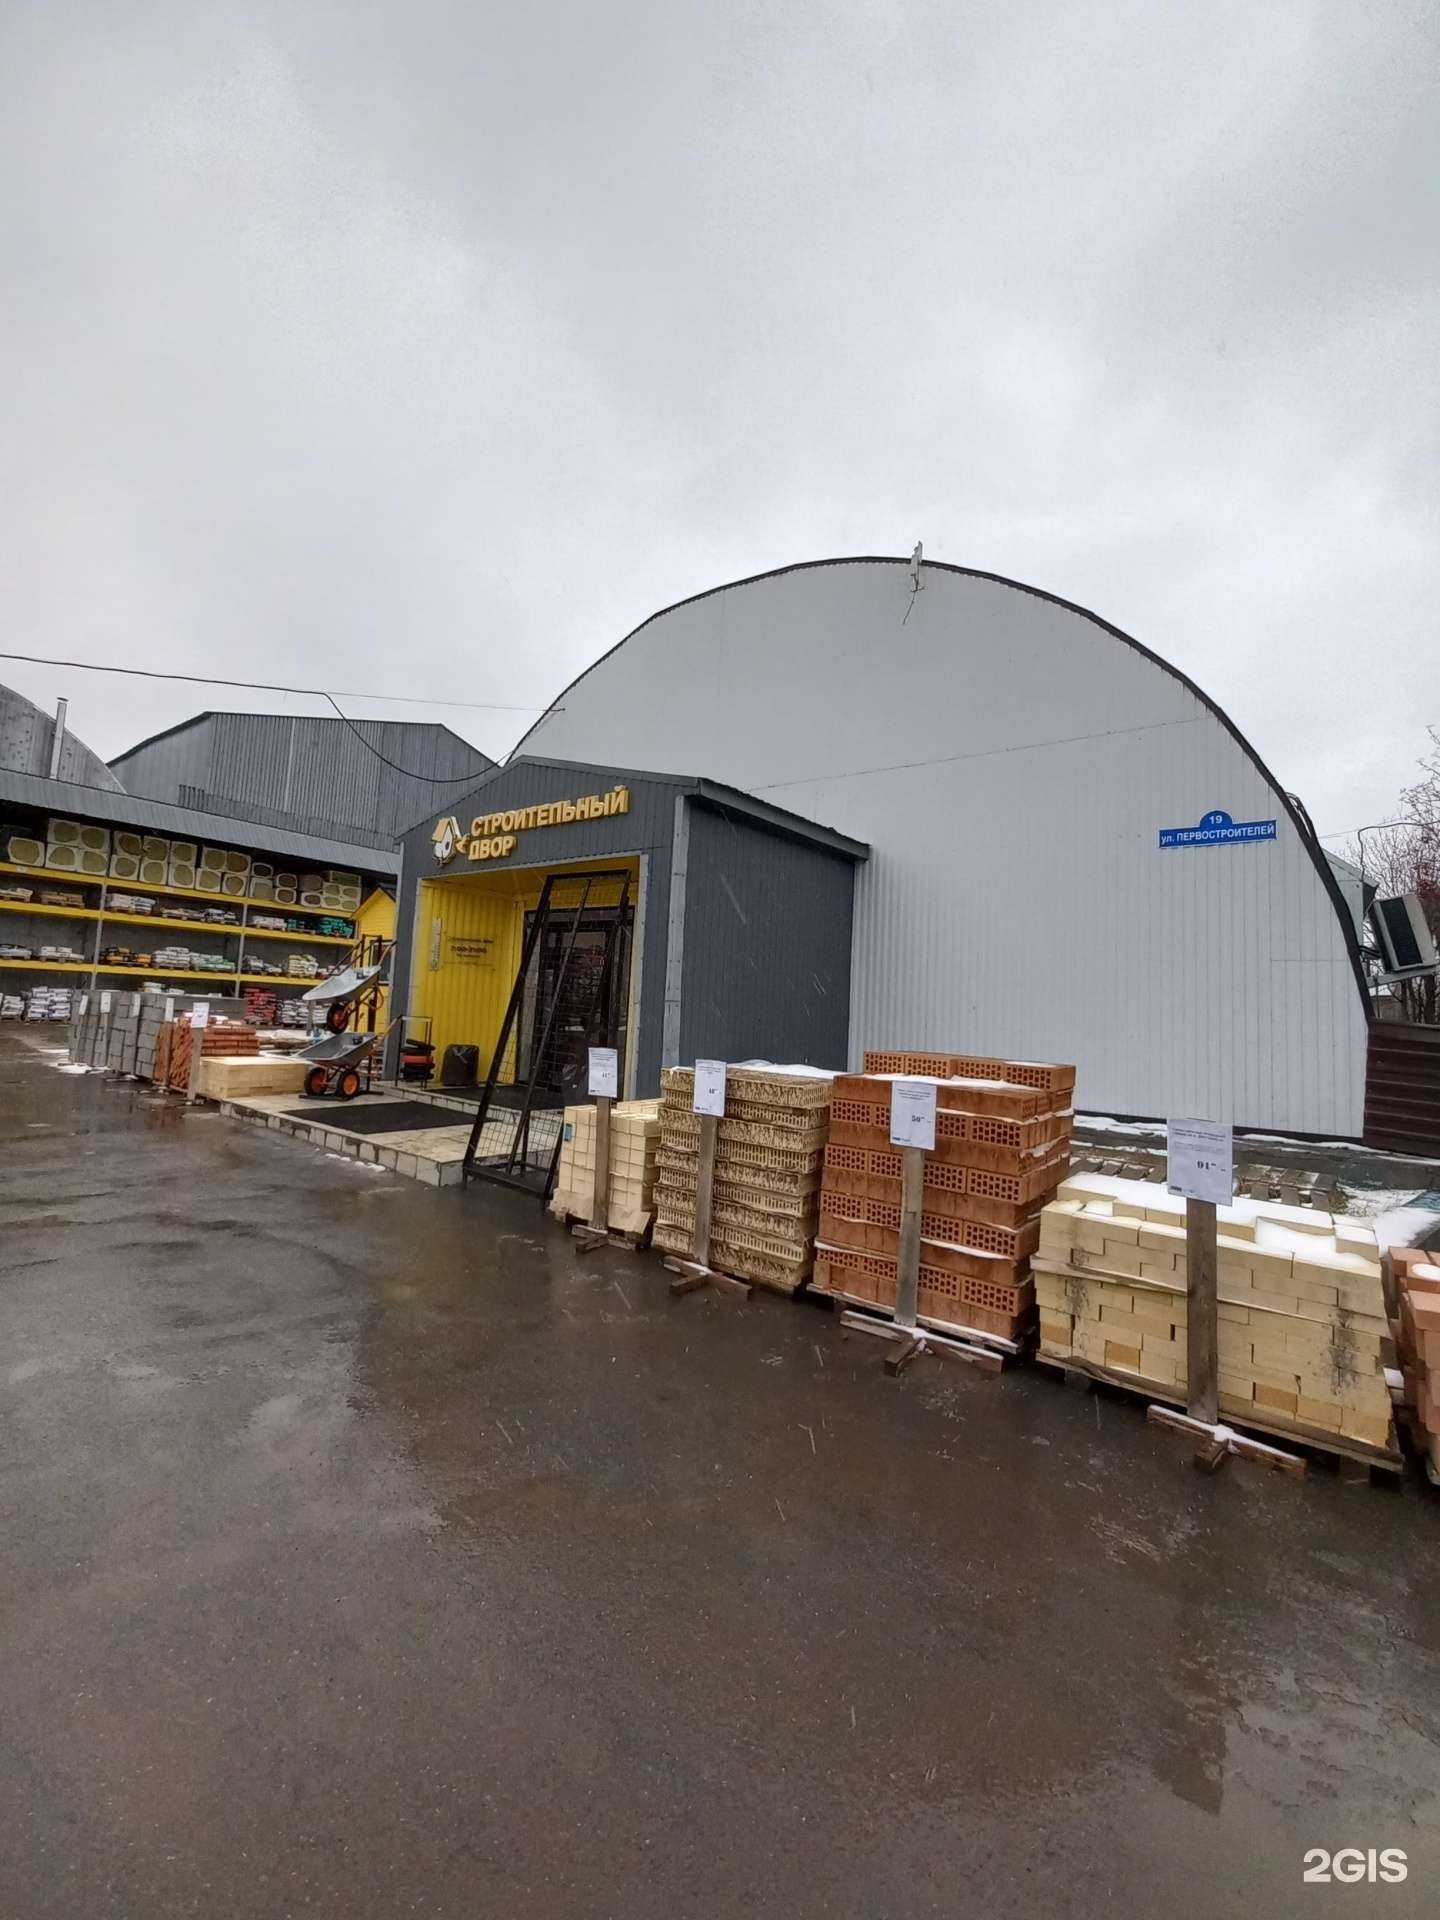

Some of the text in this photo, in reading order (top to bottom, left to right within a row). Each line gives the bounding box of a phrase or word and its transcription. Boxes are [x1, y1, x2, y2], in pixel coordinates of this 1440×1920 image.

[470, 784, 630, 837] СТРОИТЕЛЬНЫЙ
[1208, 815, 1223, 825] 19
[1161, 823, 1275, 845] ул. ПЕРВОСТРОИТЕЛЕЙ
[467, 835, 516, 861] ДВОР
